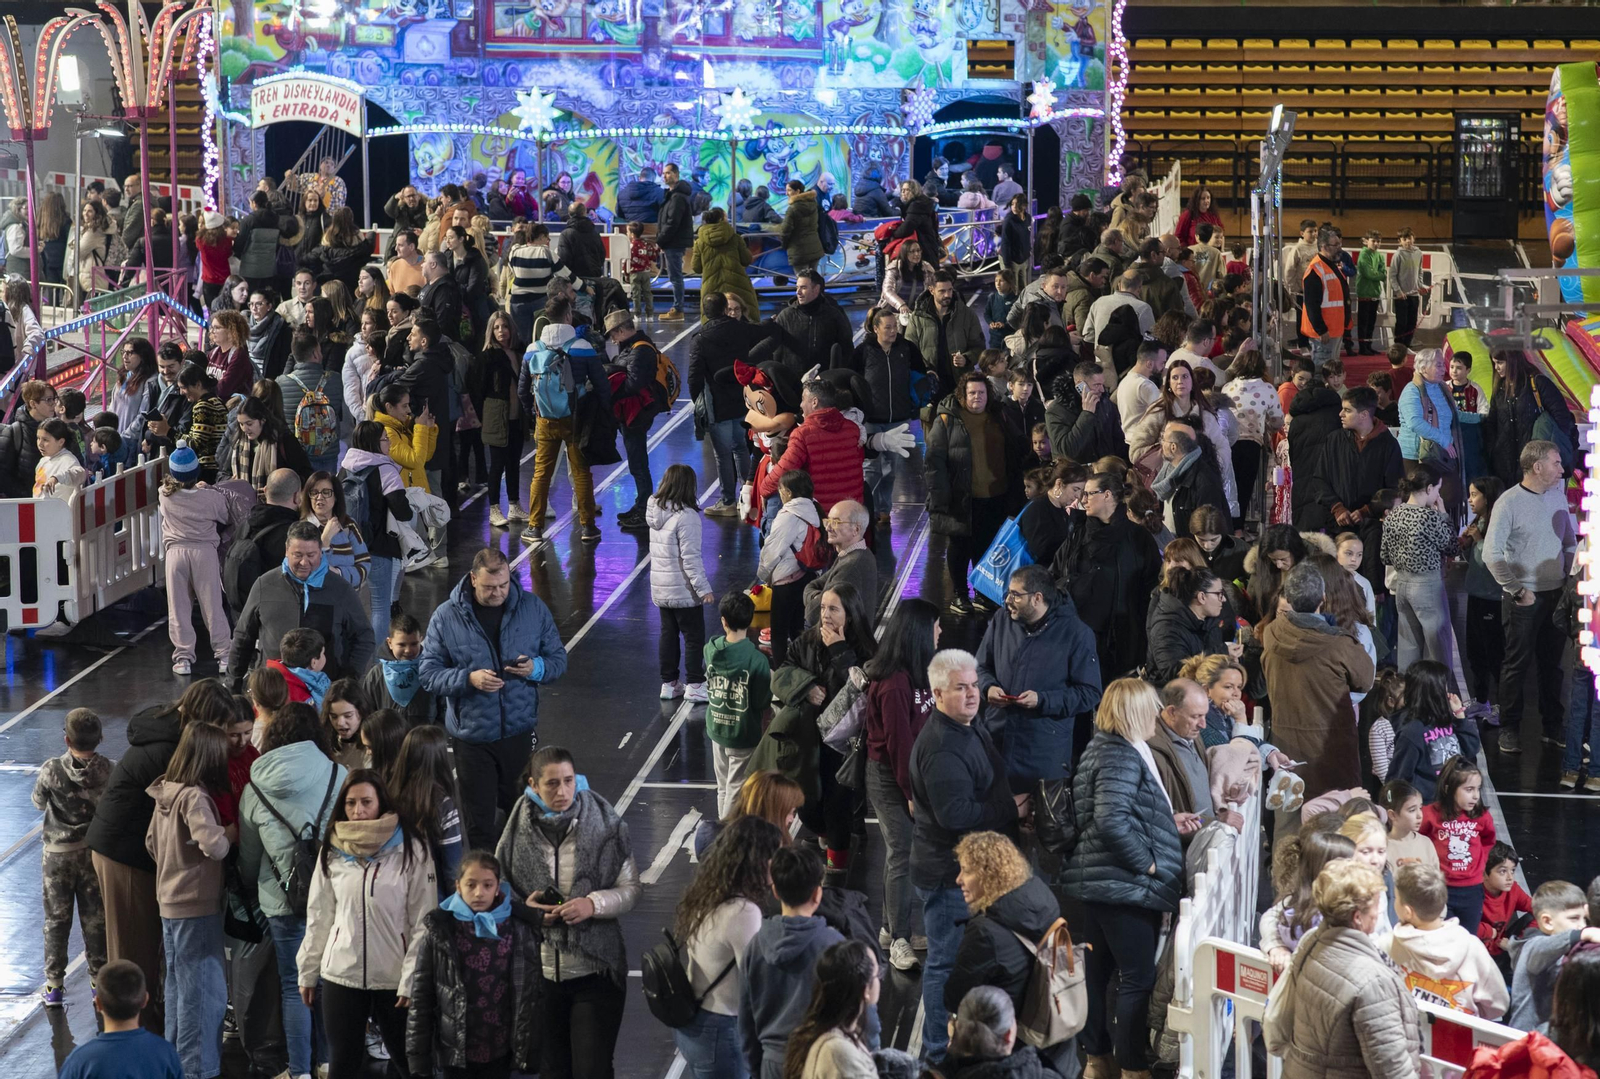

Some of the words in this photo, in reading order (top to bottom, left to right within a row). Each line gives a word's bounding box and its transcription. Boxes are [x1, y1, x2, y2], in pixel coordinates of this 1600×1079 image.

[254, 87, 278, 107] TREN
[283, 84, 358, 114] DISNEYLANDIA
[272, 103, 339, 122] ENTRADA
[1442, 820, 1478, 830] Merry
